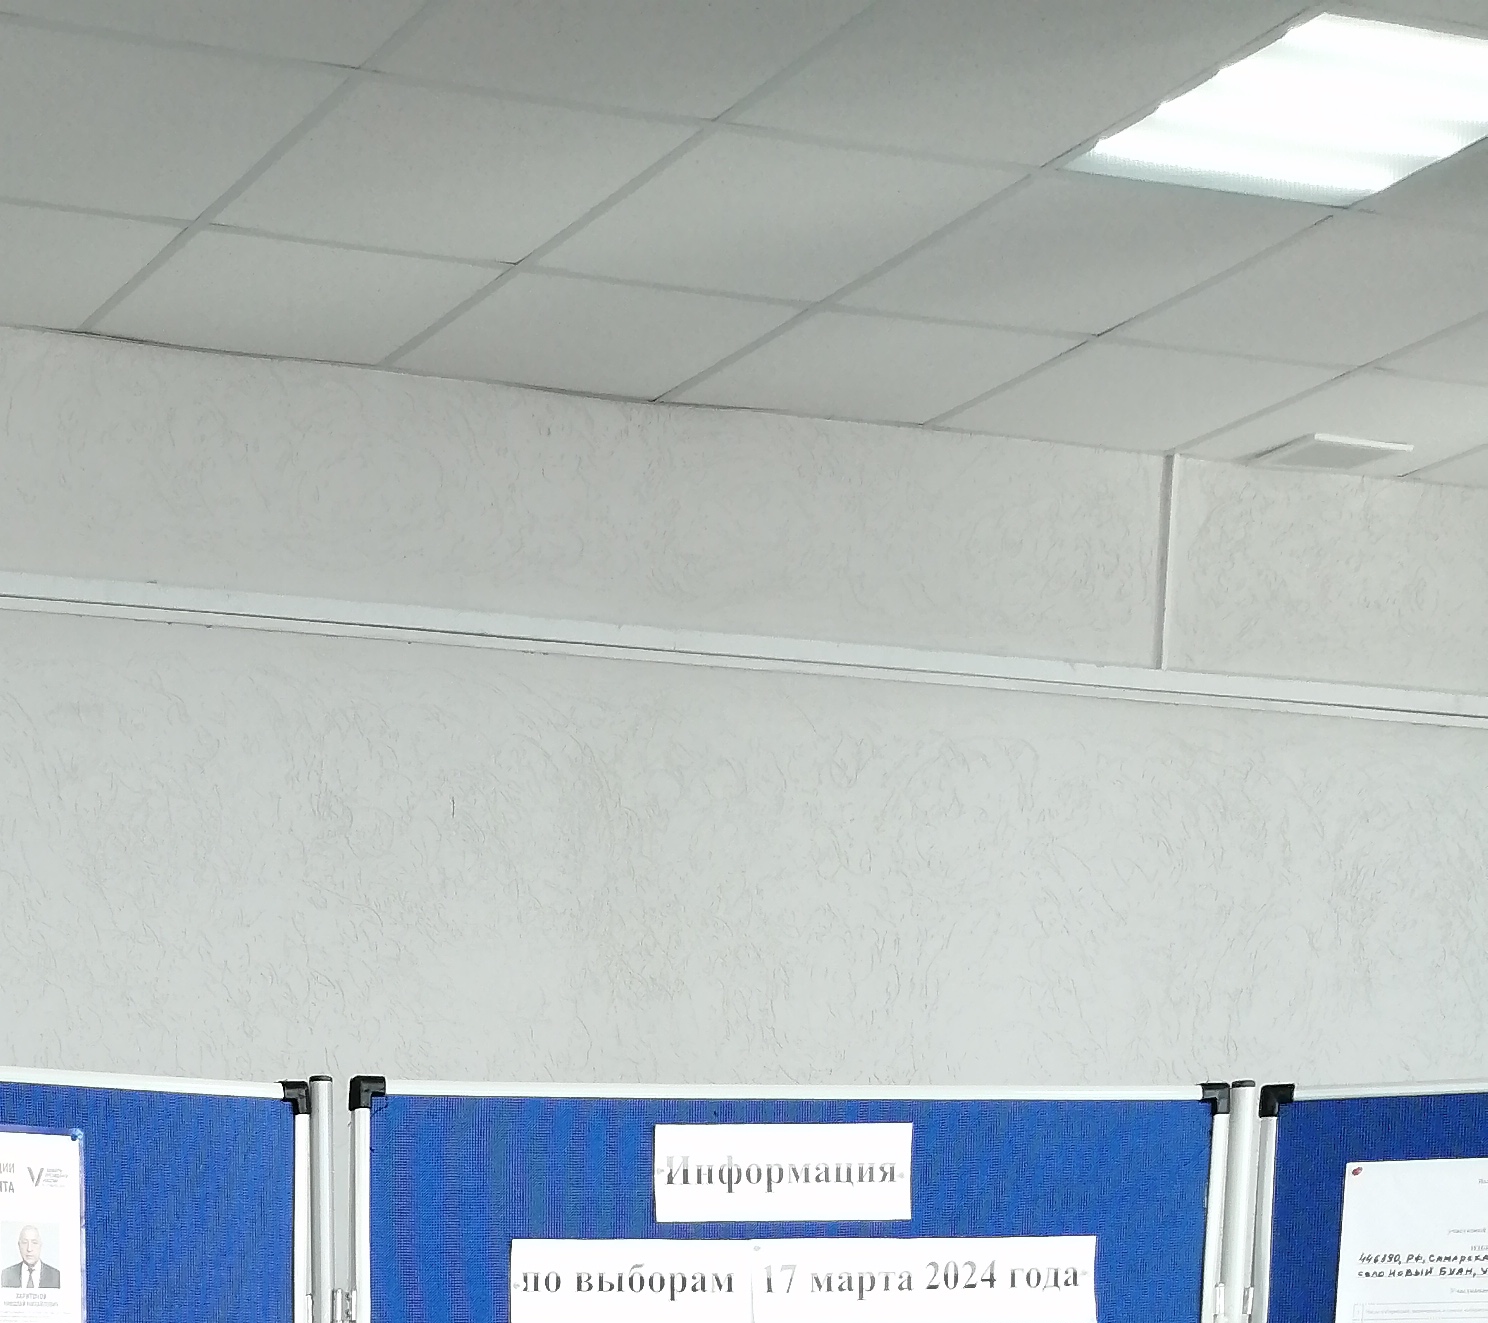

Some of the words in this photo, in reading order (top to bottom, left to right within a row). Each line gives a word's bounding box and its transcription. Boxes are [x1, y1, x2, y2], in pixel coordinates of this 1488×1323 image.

[665, 1155, 897, 1193] Информация
[522, 1271, 561, 1293] по
[575, 1263, 735, 1302] выборам
[764, 1264, 797, 1293] 17
[810, 1270, 914, 1301] марта
[925, 1259, 997, 1290] 2024
[1009, 1266, 1080, 1292] года
